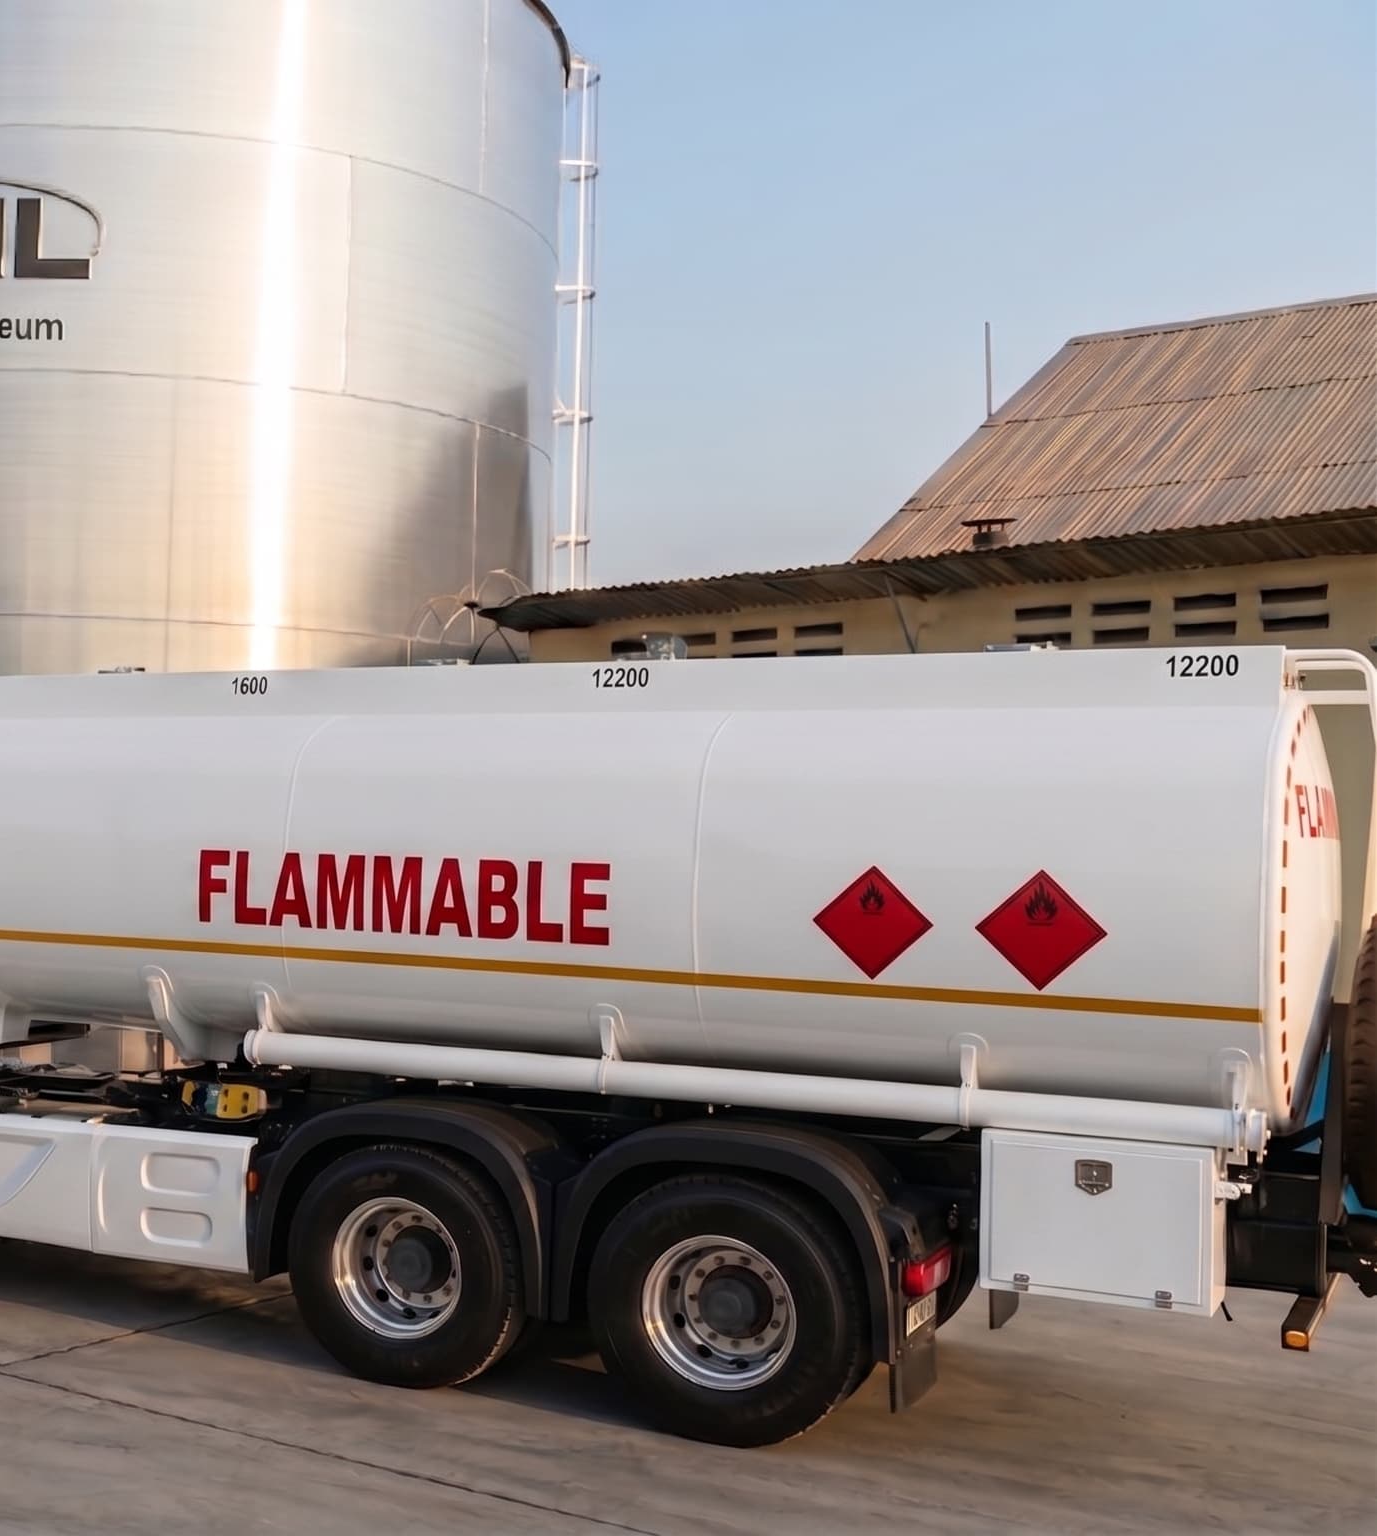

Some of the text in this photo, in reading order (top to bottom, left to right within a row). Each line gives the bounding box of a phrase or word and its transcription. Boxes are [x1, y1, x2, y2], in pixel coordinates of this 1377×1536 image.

[591, 666, 650, 690] 12200
[1165, 654, 1239, 679] 12200
[232, 675, 268, 695] 1600
[198, 849, 611, 946] FLAMMABLE
